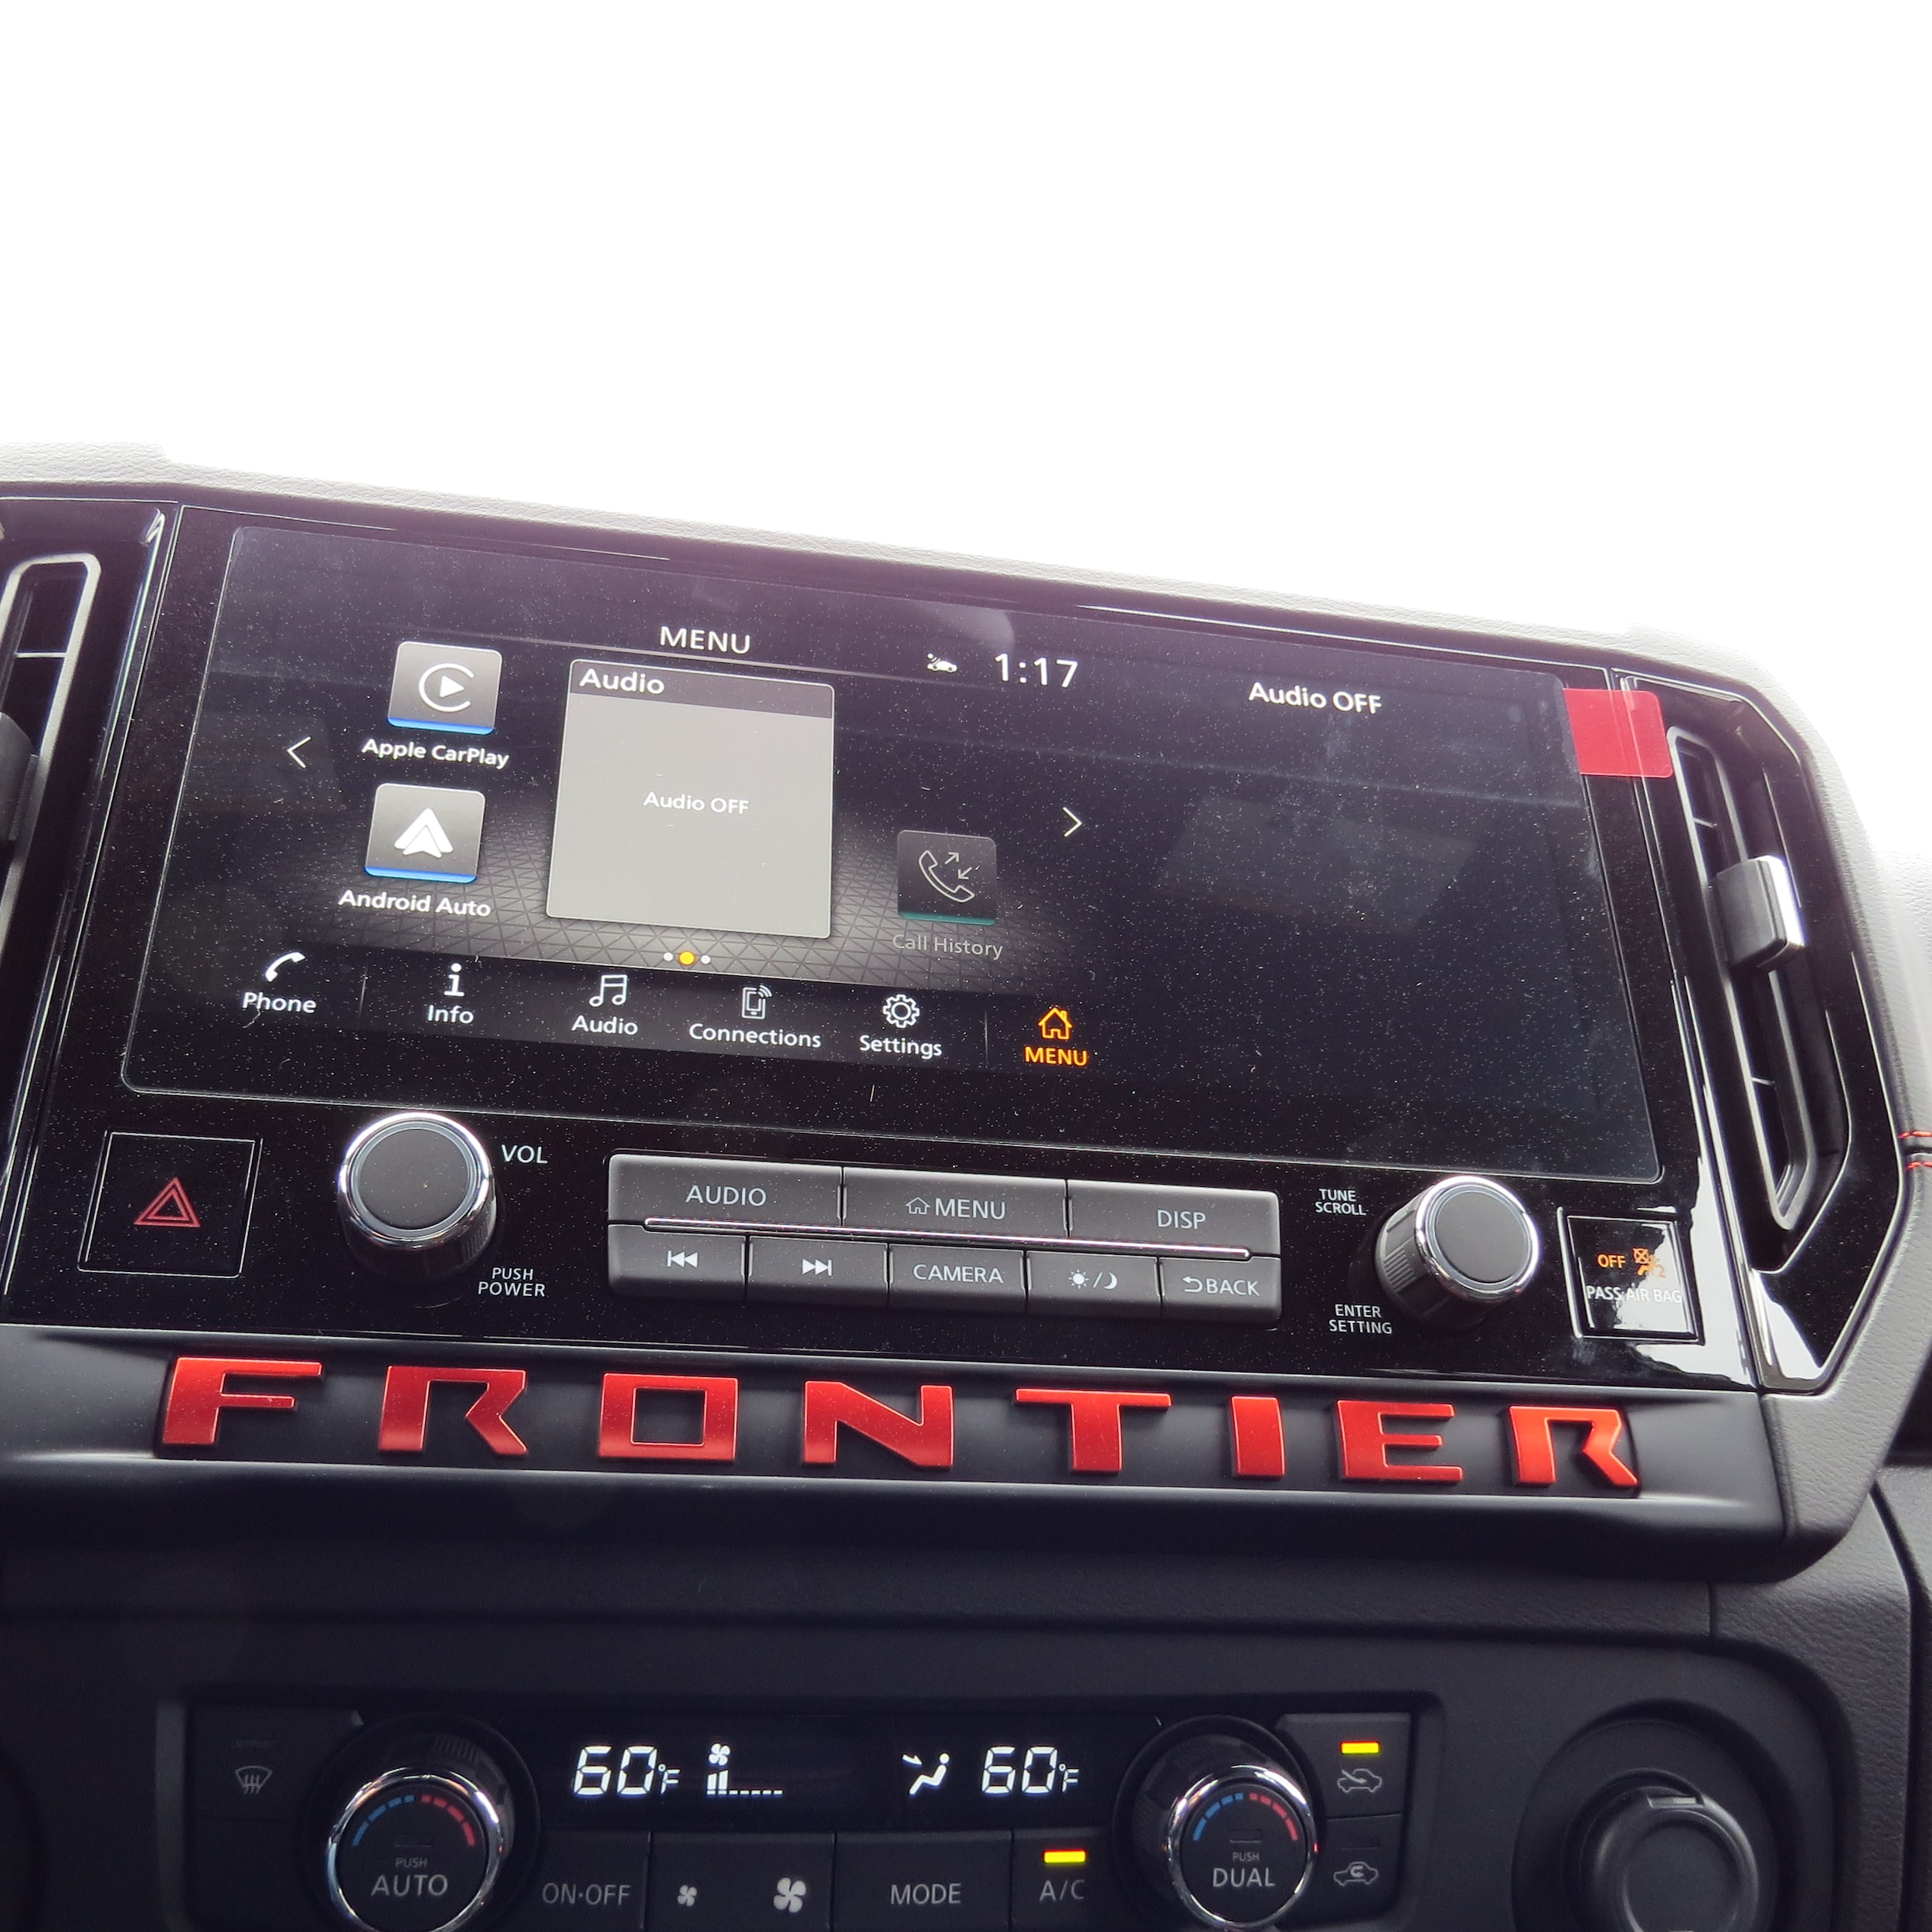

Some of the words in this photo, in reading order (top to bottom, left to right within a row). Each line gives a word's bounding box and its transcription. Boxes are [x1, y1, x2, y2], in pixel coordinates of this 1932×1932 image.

[659, 626, 751, 655] MENU
[579, 668, 665, 695] Audio
[995, 653, 1079, 689] 1:17
[1249, 682, 1327, 709] Audio
[1334, 689, 1382, 715] OFF
[361, 738, 427, 760] Apple
[431, 743, 509, 770] CarPlay
[643, 791, 706, 813] Audio
[709, 797, 750, 815] OFF
[338, 889, 430, 914] Android
[436, 896, 492, 917] Auto
[892, 934, 928, 952] Call
[934, 936, 1003, 961] History
[242, 991, 317, 1015] Phone
[427, 1004, 474, 1025] Info
[572, 1015, 638, 1036] Audio
[689, 1022, 821, 1049] Connections
[859, 1034, 942, 1061] Settings
[1024, 1045, 1088, 1067] MENU
[501, 1144, 548, 1165] VOL
[685, 1185, 767, 1207] AUDIO
[1319, 1189, 1356, 1202] TUNE
[936, 1199, 1006, 1220] MENU
[1155, 1208, 1209, 1230] DISP
[1315, 1201, 1366, 1216] SCROLL
[1597, 1253, 1626, 1269] OFF
[492, 1267, 534, 1281] PUSH
[913, 1264, 1004, 1284] CAMERA
[478, 1281, 546, 1298] POWER
[1205, 1277, 1260, 1298] BACK
[1587, 1284, 1622, 1301] PASS
[1625, 1286, 1651, 1301] AIR
[1653, 1287, 1682, 1303] BAG
[1335, 1304, 1382, 1318] ENTER
[1328, 1318, 1393, 1335] SETTING
[161, 1357, 1639, 1488] FRONTIER
[395, 1858, 427, 1868] PUSH
[1232, 1852, 1260, 1862] PUSH
[371, 1874, 448, 1896] AUTO
[1212, 1866, 1275, 1888] DUAL
[890, 1883, 962, 1905] MODE
[1039, 1880, 1085, 1902] A/C
